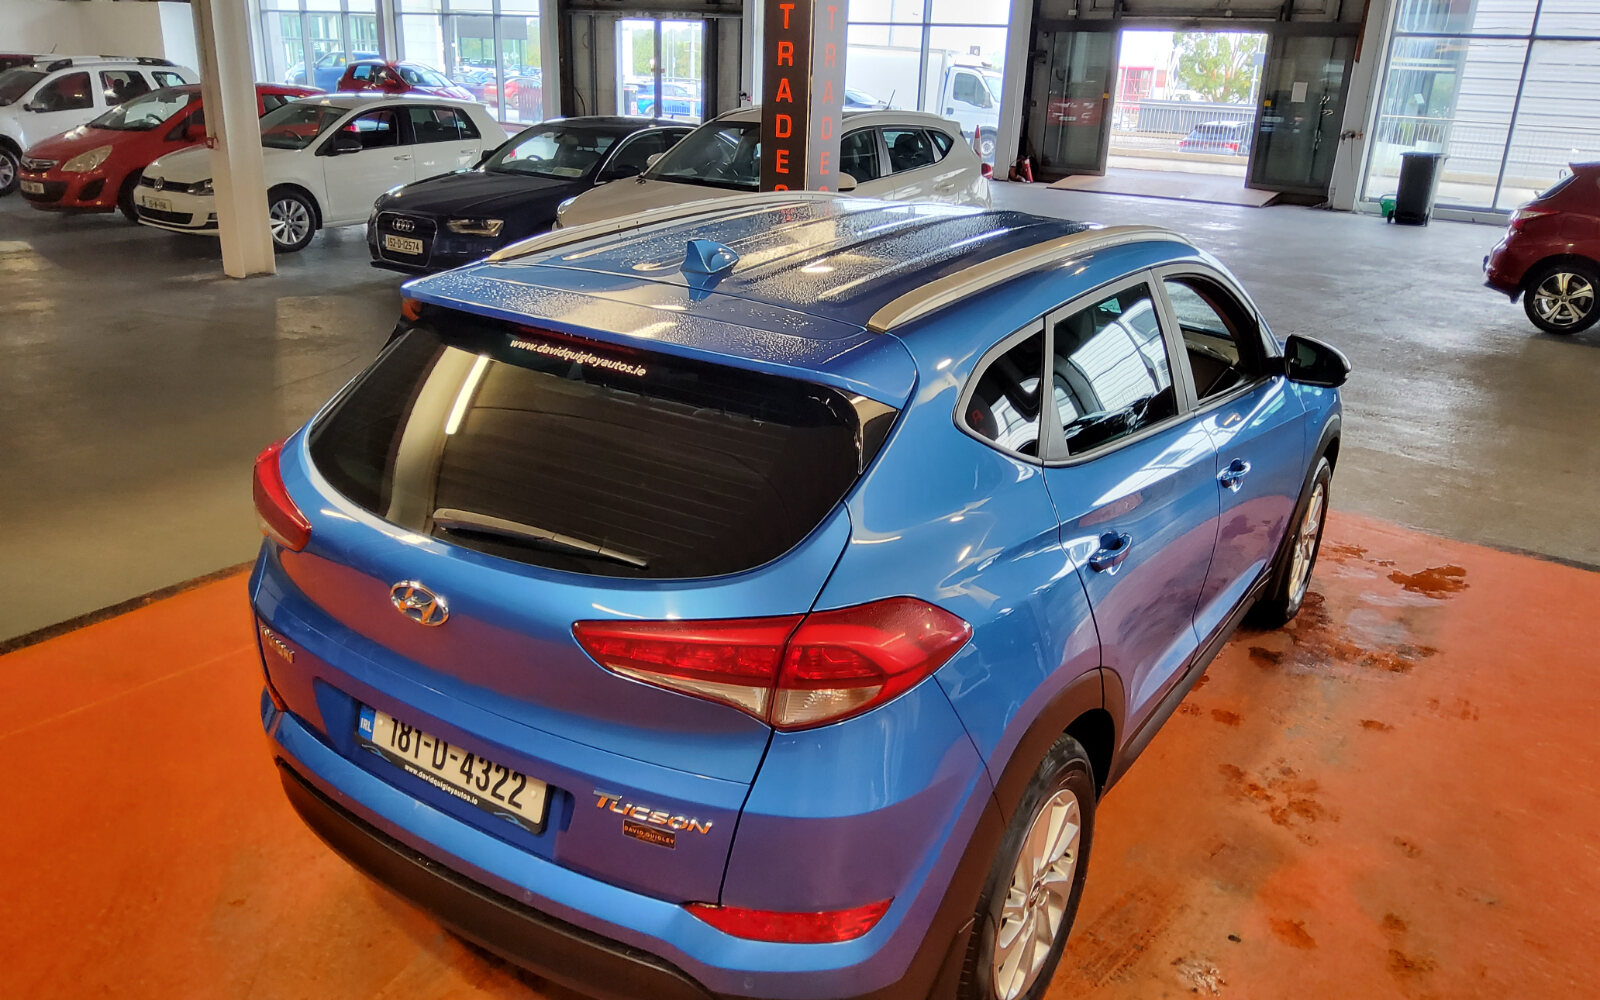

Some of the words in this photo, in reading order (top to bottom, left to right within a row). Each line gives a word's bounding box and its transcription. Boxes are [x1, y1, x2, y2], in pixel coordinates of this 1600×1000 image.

[510, 339, 646, 377] www.davidquigleyautos.ie
[360, 717, 372, 733] IRL
[390, 717, 527, 810] 181-D-4322
[593, 790, 713, 835] TUCSON
[624, 825, 644, 837] DAVID
[645, 832, 675, 845] QUIGLEY
